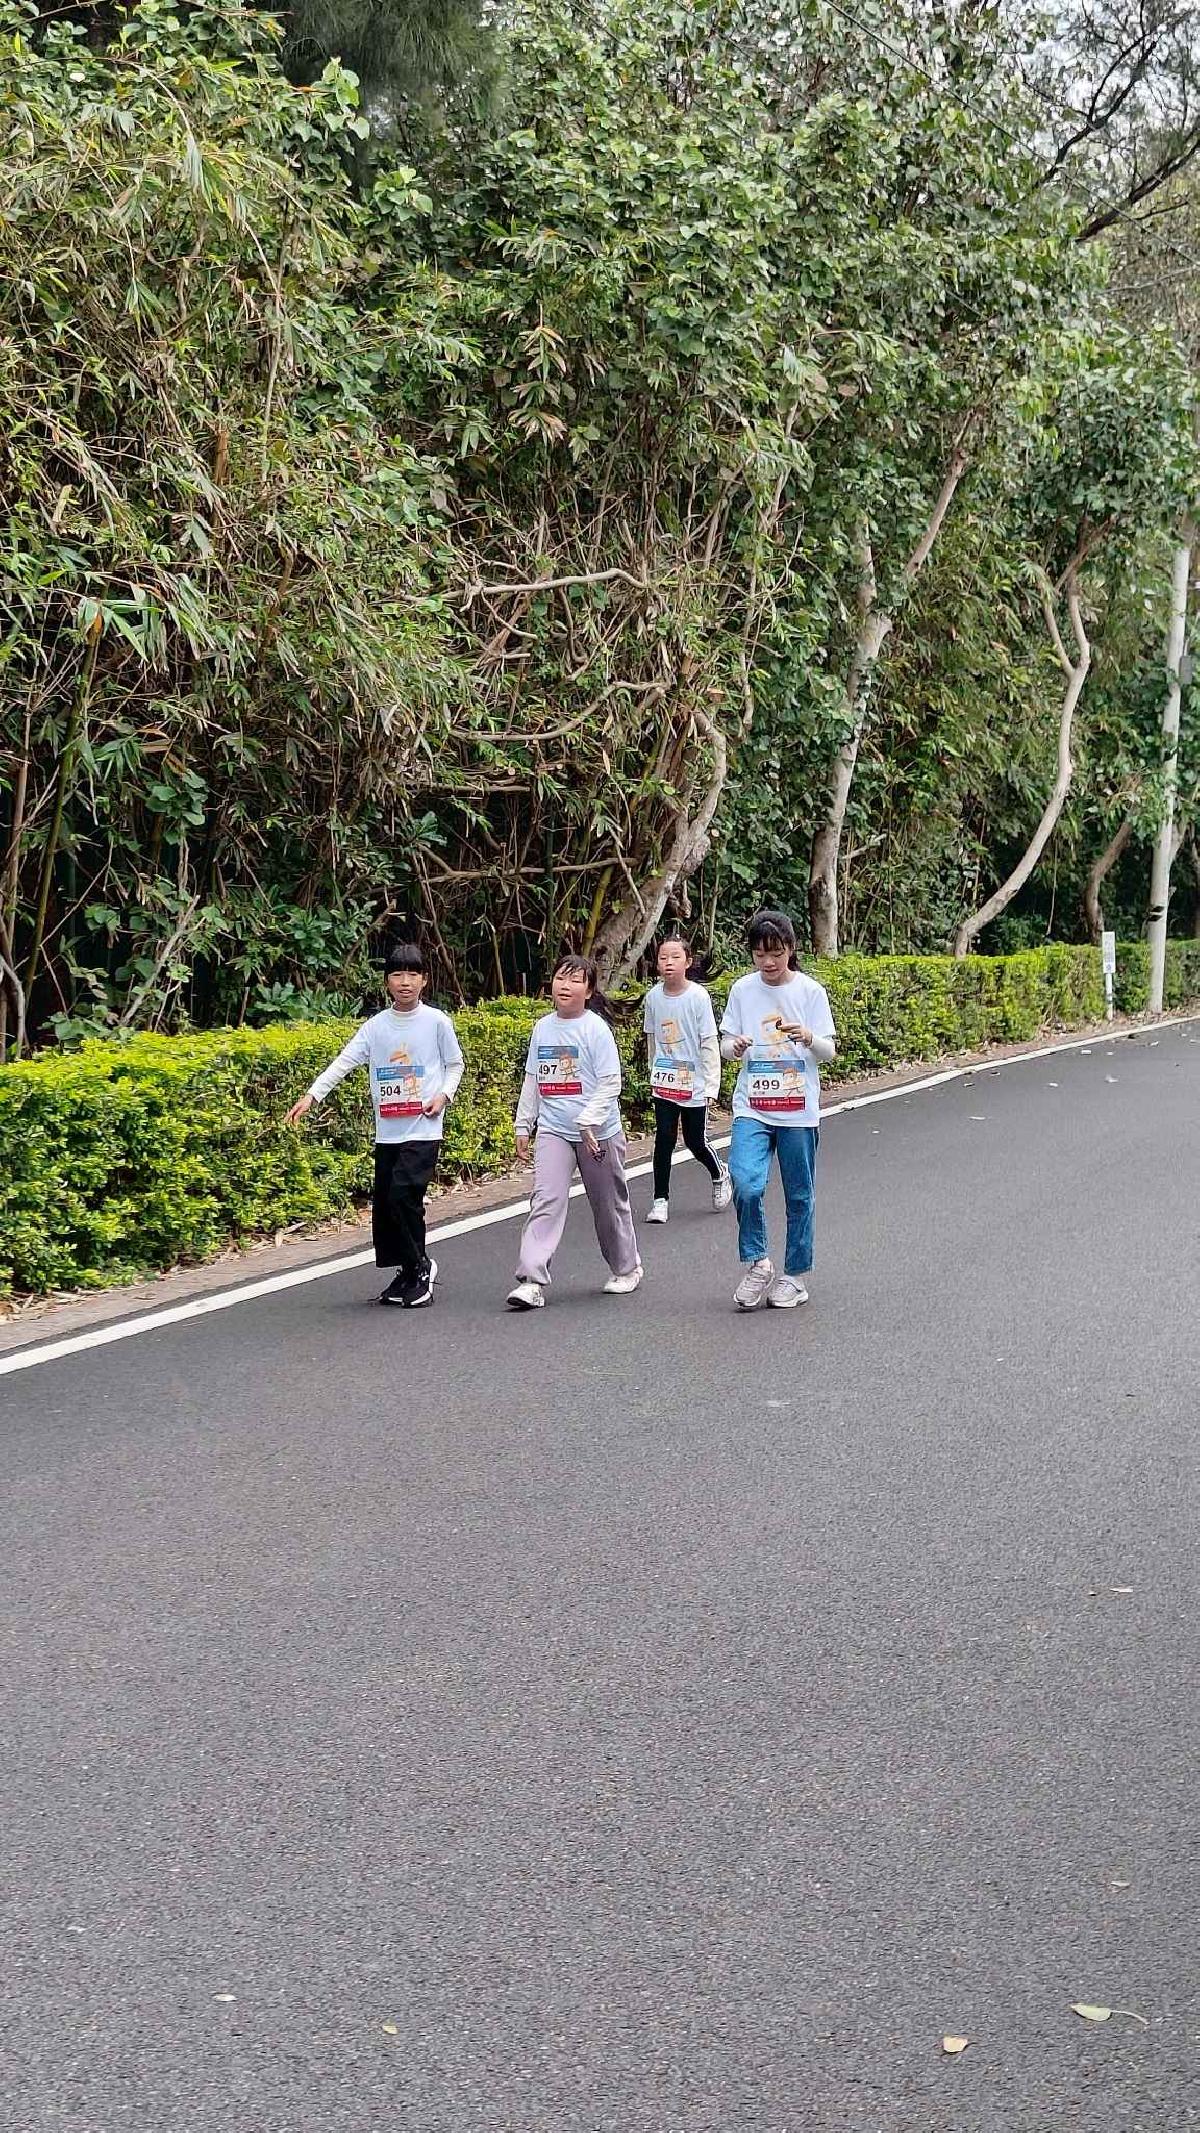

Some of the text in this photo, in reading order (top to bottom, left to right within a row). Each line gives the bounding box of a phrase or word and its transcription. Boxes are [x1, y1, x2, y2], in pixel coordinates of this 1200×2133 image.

[539, 1064, 557, 1075] 497
[654, 1072, 675, 1082] 476
[752, 1079, 780, 1090] 499
[380, 1085, 401, 1096] 504
